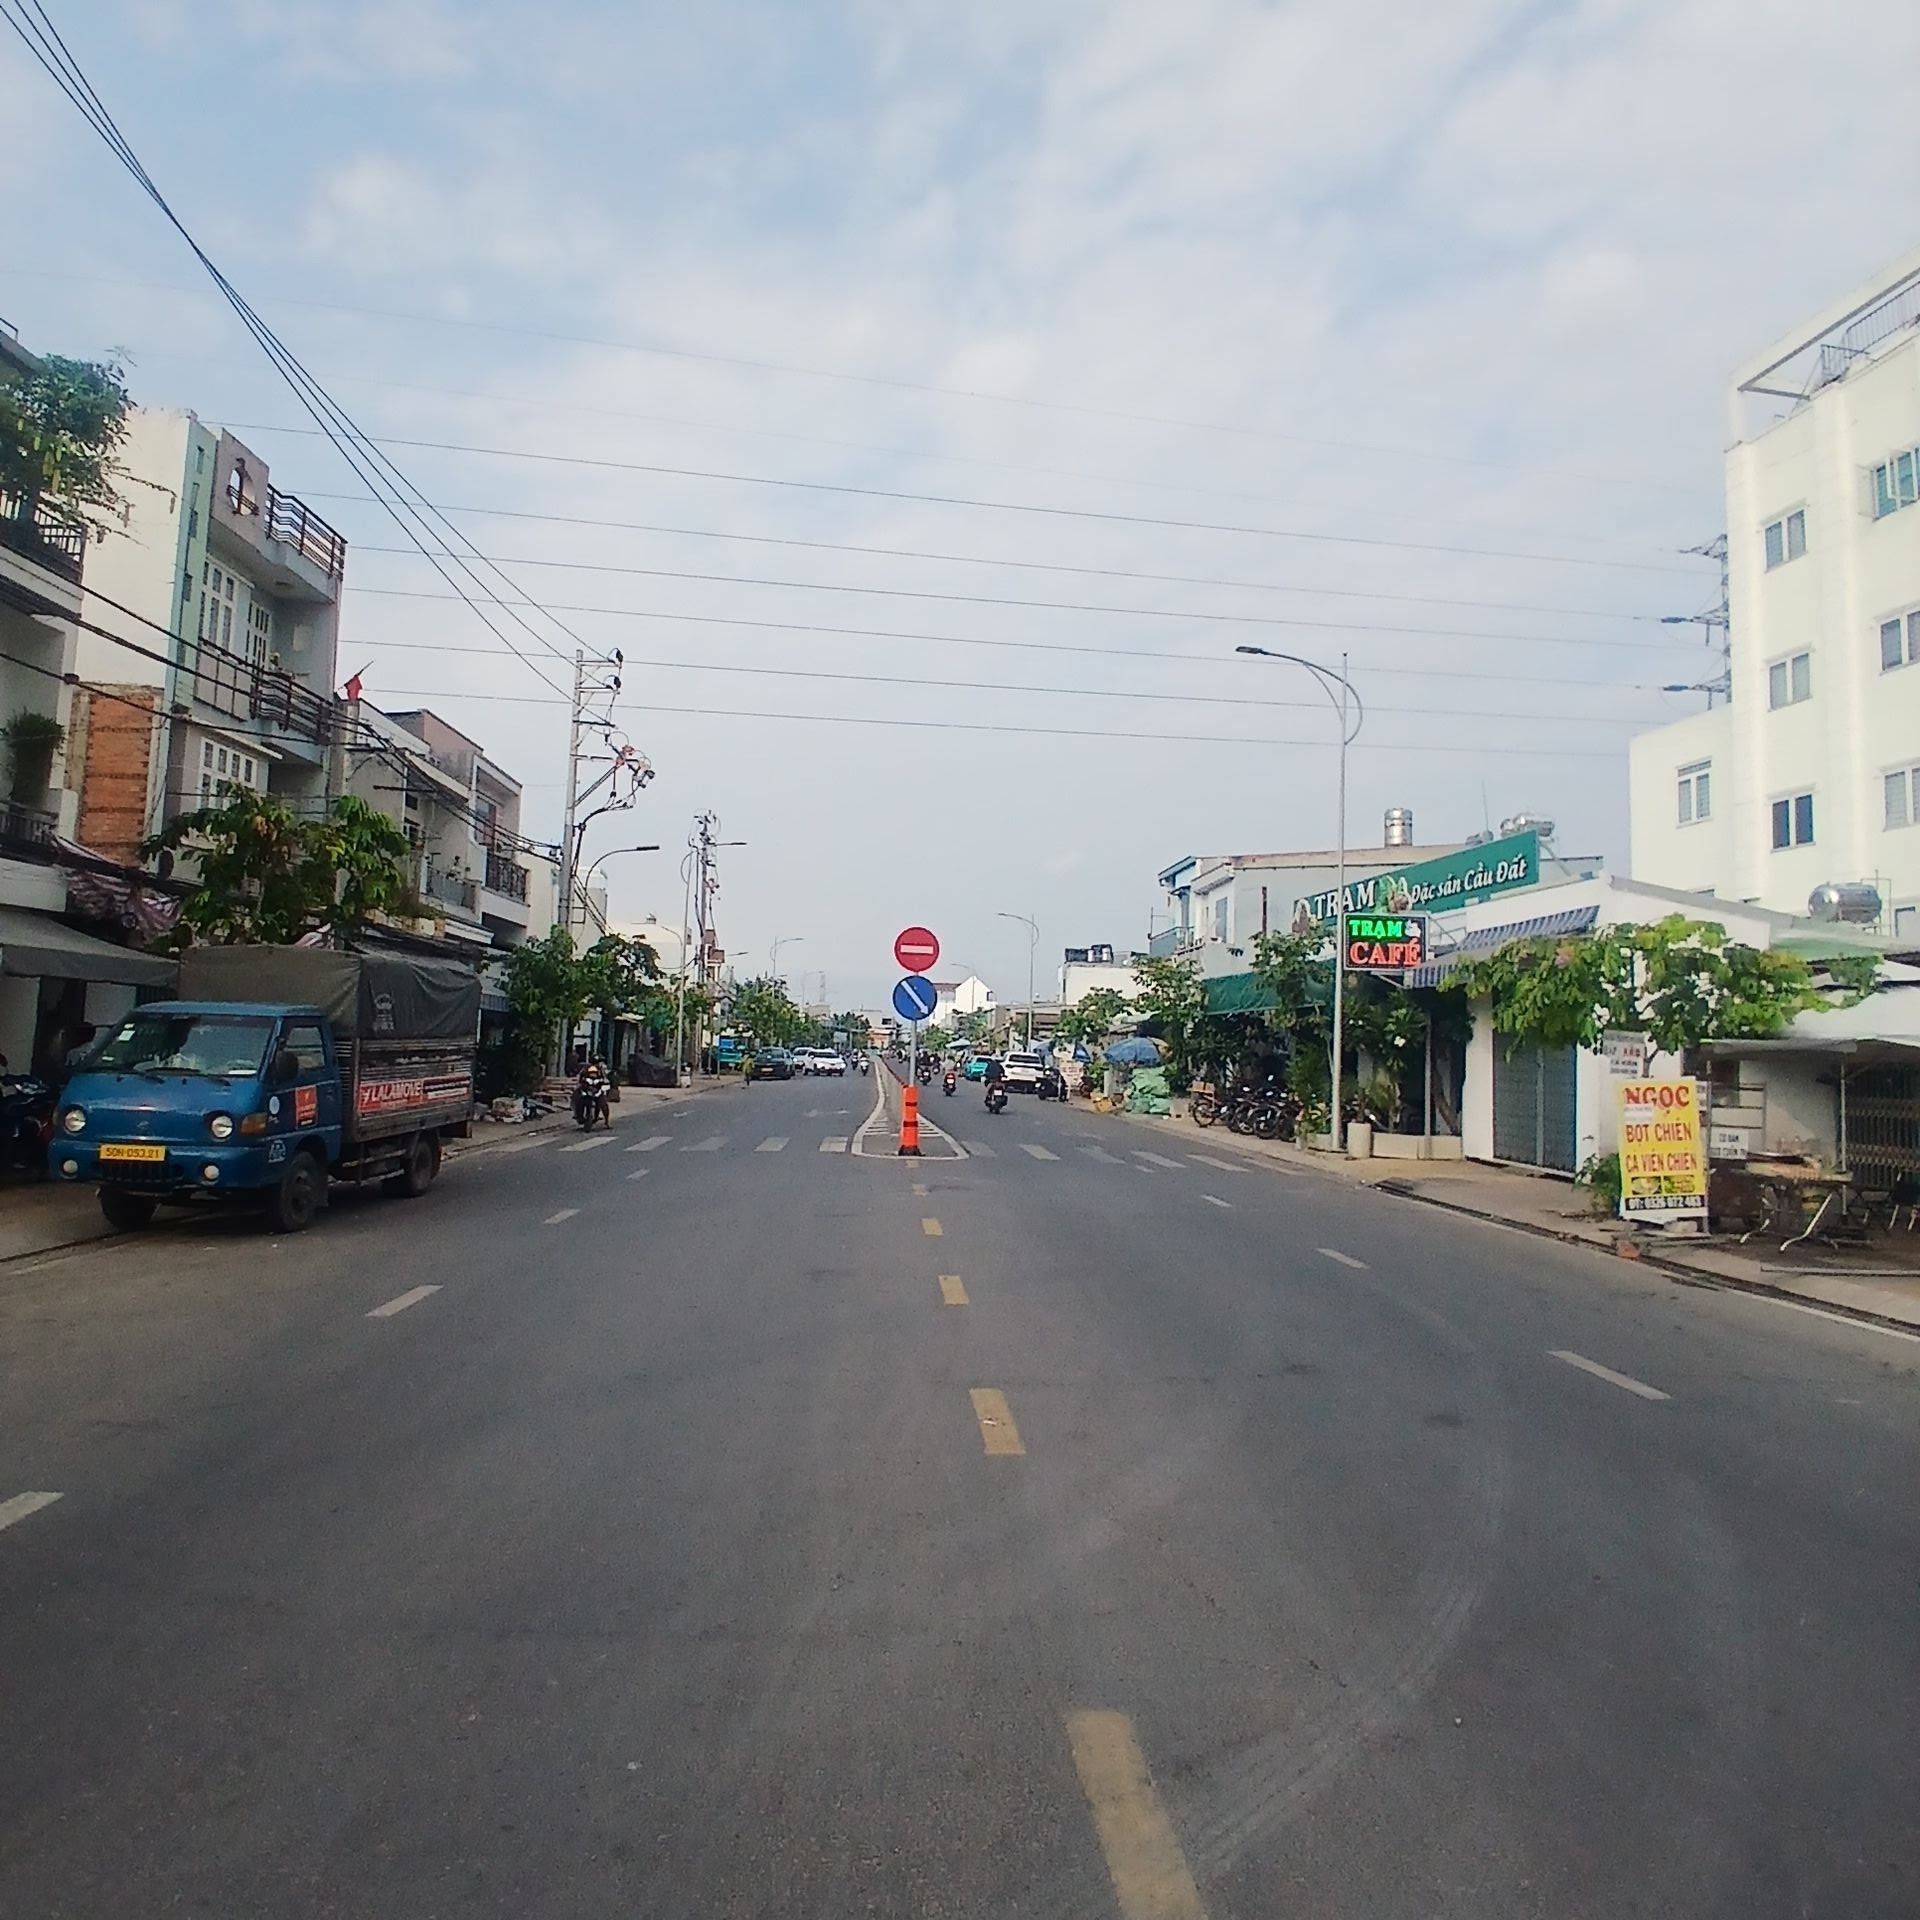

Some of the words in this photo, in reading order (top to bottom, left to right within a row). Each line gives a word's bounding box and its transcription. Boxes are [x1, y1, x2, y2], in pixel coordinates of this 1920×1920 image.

[1411, 882, 1436, 904] Đặc
[1464, 861, 1493, 891] Cầu
[1496, 853, 1527, 883] Đất
[1348, 919, 1403, 939] TRẠM
[1349, 938, 1421, 966] CAFÉ
[1623, 1085, 1690, 1114] NGỌC
